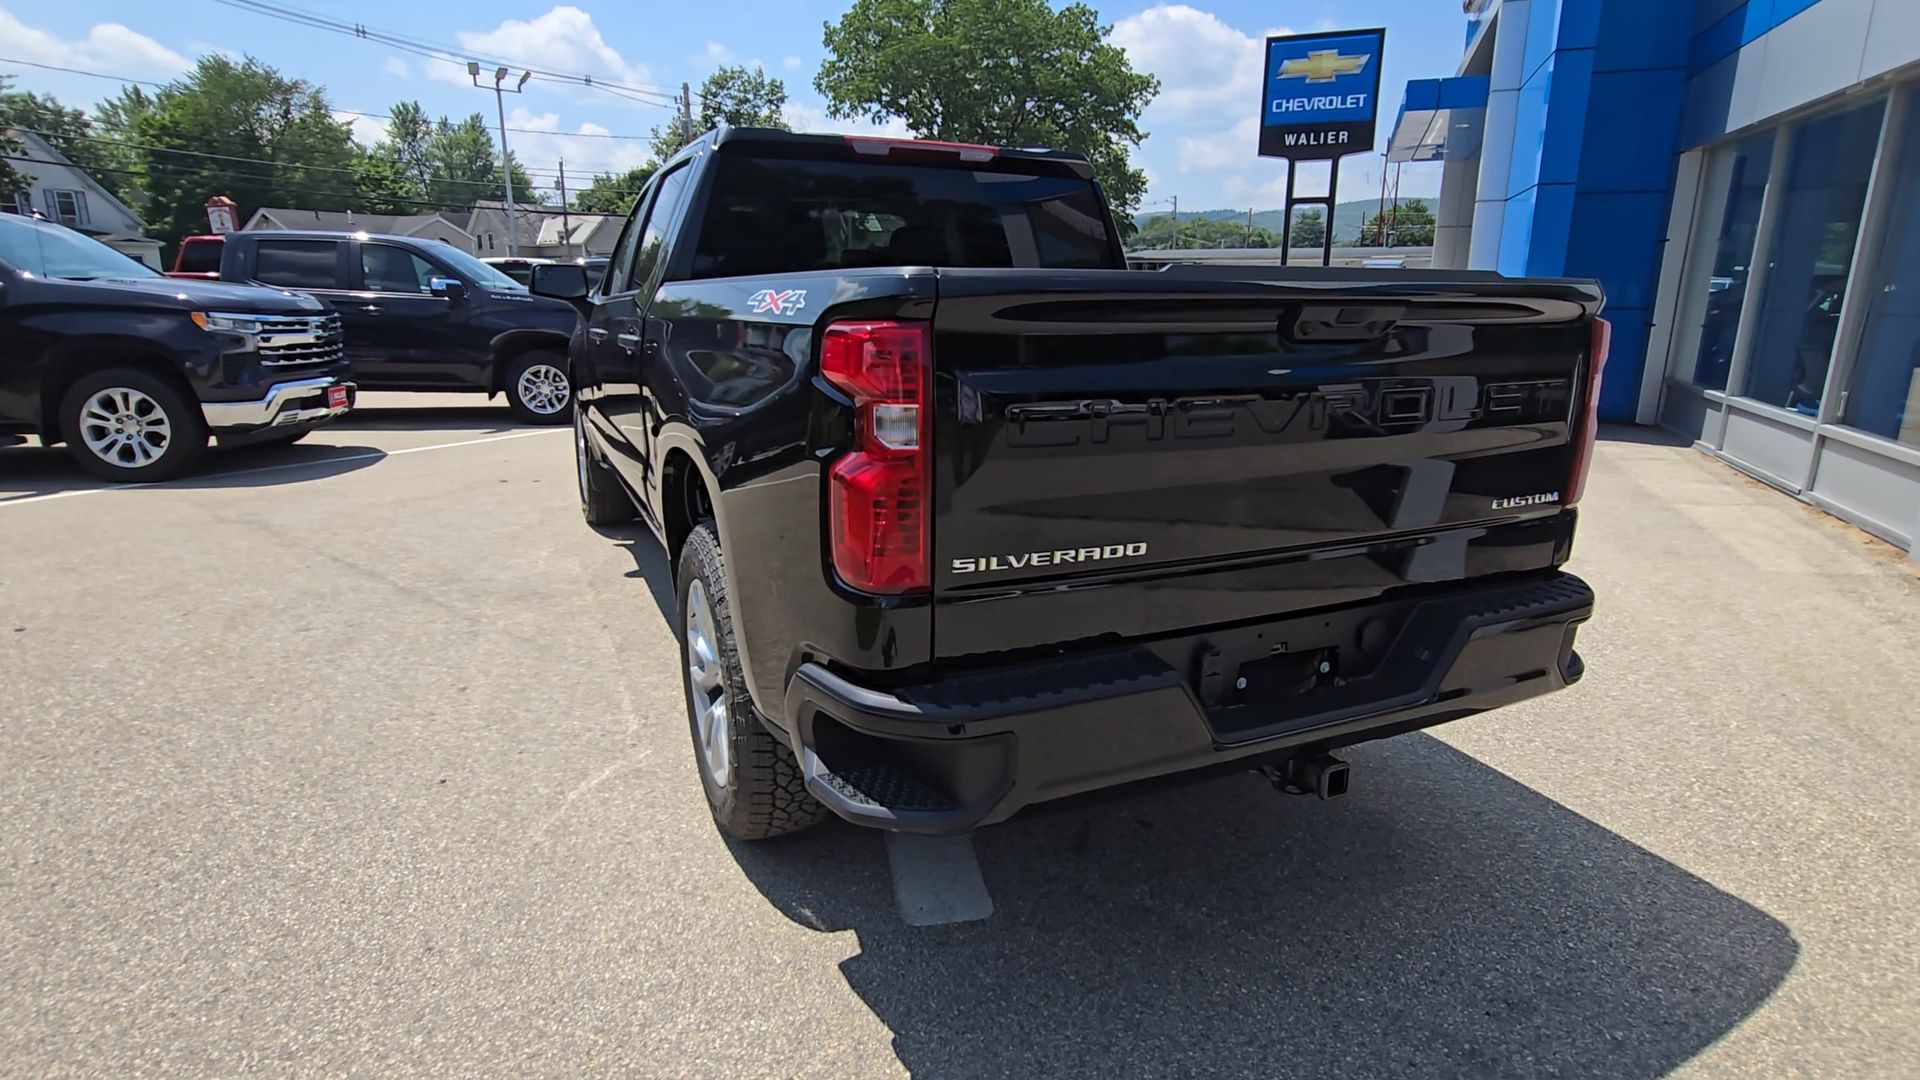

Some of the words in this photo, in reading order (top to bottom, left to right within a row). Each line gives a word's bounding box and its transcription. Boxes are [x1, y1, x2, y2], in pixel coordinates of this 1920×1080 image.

[1272, 94, 1367, 112] CHEVROLET
[1285, 131, 1348, 146] WALIER
[1005, 379, 1567, 448] CHEVROLET
[1491, 491, 1559, 509] CUSTOM
[952, 542, 1148, 573] SILVERADO
